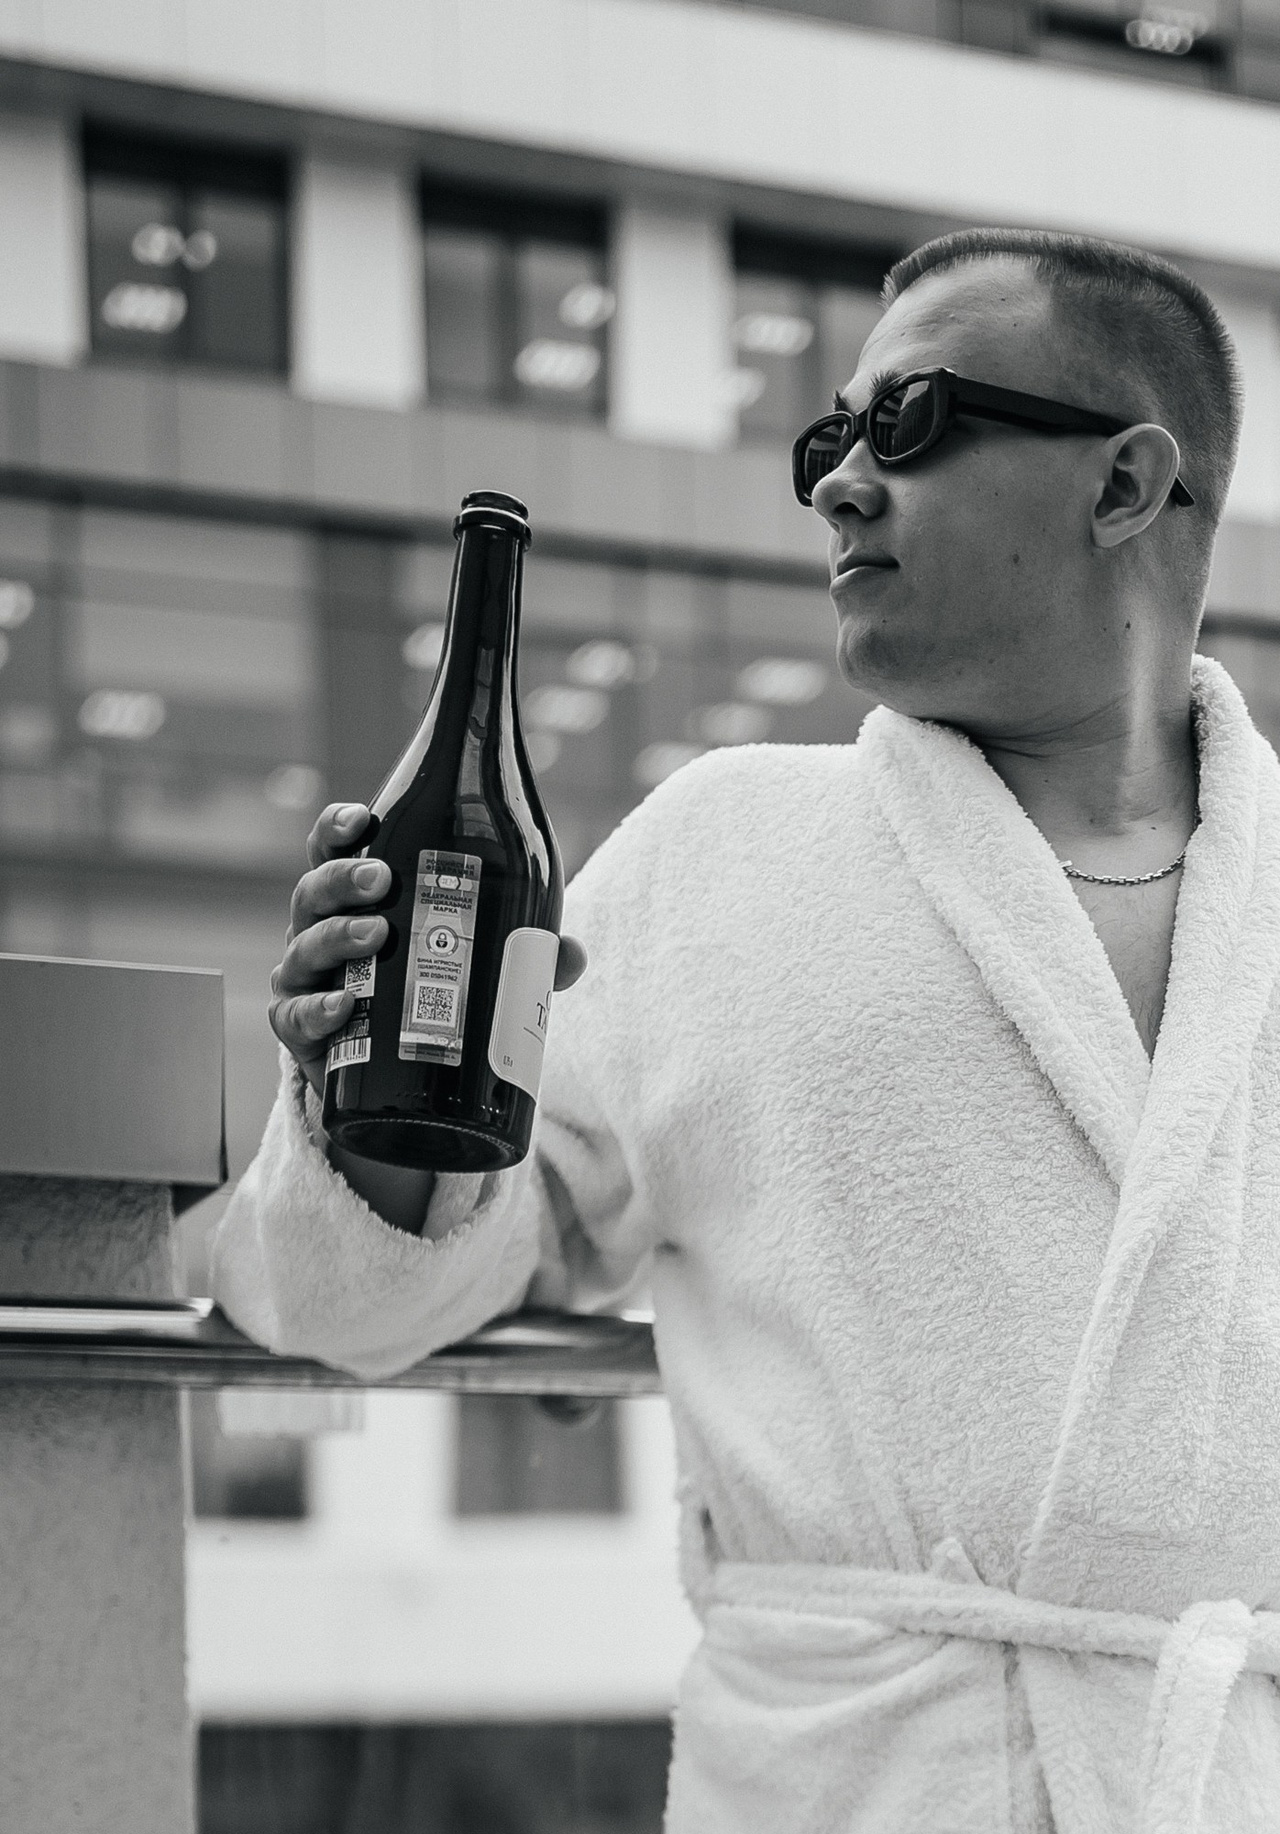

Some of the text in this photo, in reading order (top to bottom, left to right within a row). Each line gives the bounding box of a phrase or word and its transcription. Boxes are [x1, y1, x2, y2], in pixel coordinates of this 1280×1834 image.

[421, 892, 473, 904] ФЕДЕРАЛЬНАЯ
[420, 898, 472, 910] СПЕЦИАЛЬНАЯ
[433, 905, 458, 914] МАРКА
[434, 959, 462, 968] ИГРИСТЫЕ
